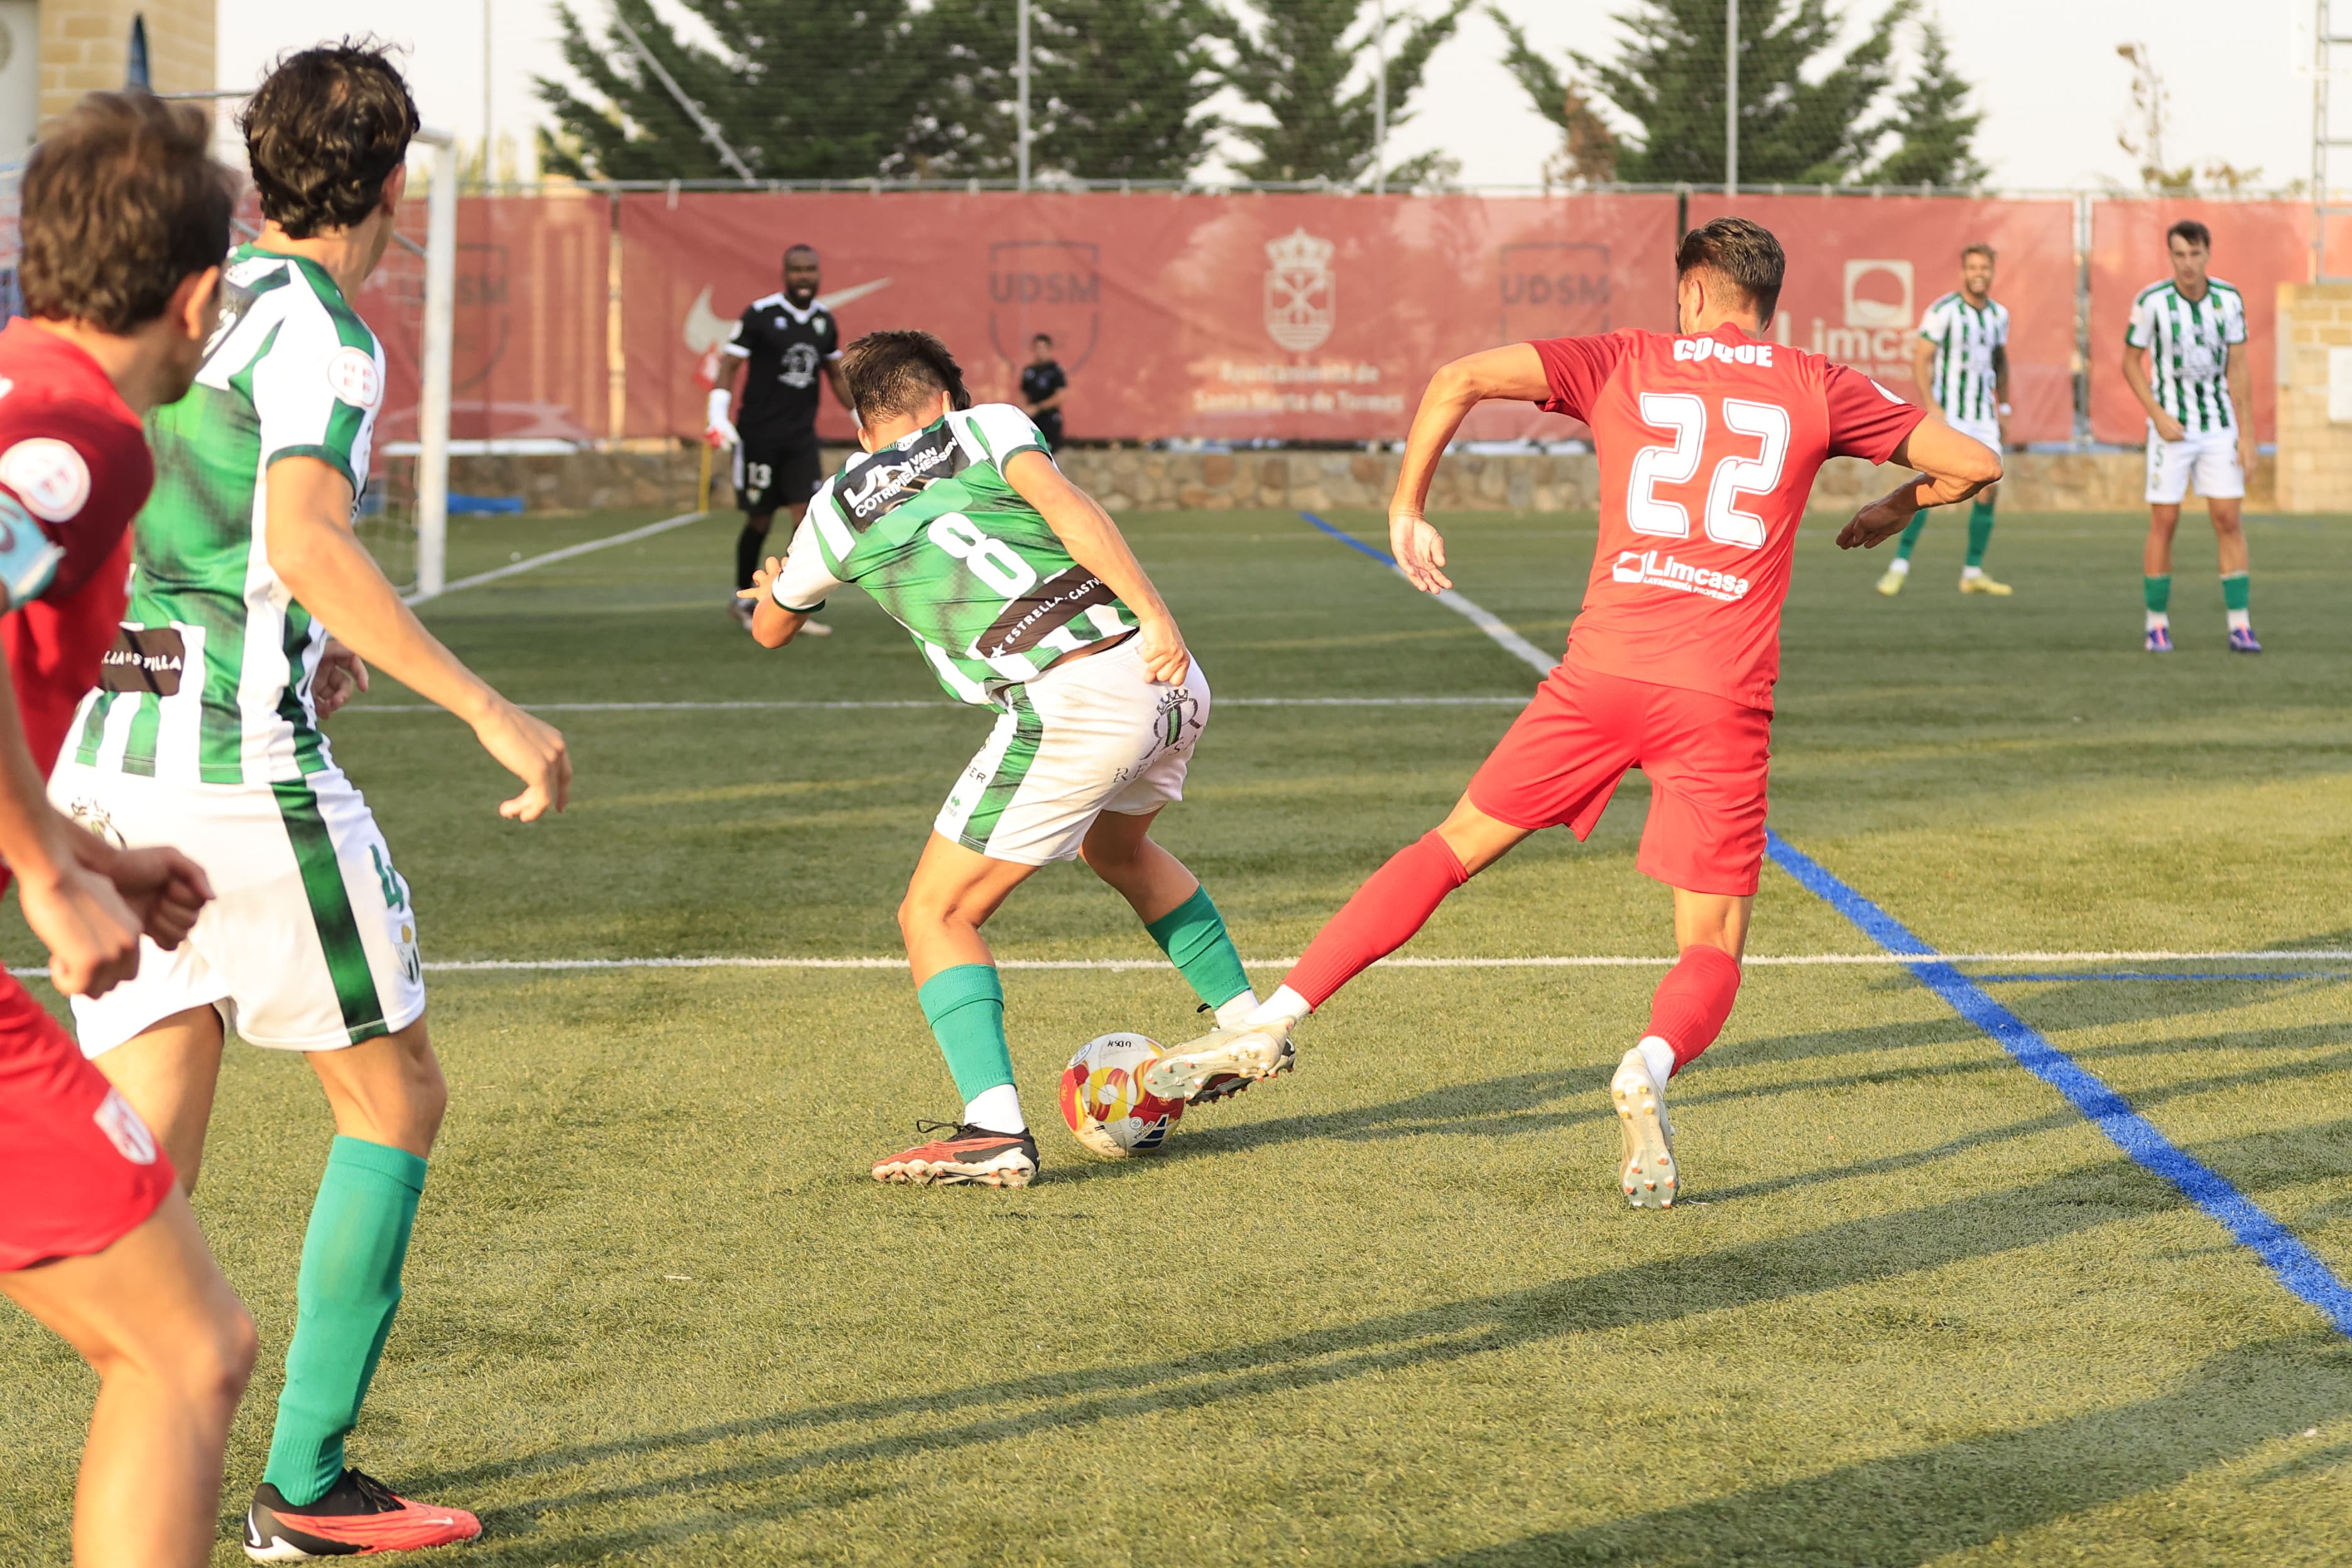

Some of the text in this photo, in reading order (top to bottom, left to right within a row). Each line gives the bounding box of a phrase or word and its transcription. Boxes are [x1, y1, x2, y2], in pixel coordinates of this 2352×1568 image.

[989, 271, 1100, 305] UDSM
[1500, 272, 1610, 305] UDSM
[748, 462, 771, 489] 13
[909, 447, 938, 466] VAN
[1626, 391, 1791, 550] 22
[927, 511, 1037, 598] 8
[1645, 550, 1749, 594] Limcasa
[1004, 596, 1067, 645] ESTRELLA
[369, 842, 405, 913] 4
[1133, 1121, 1155, 1140] VICTORIA
